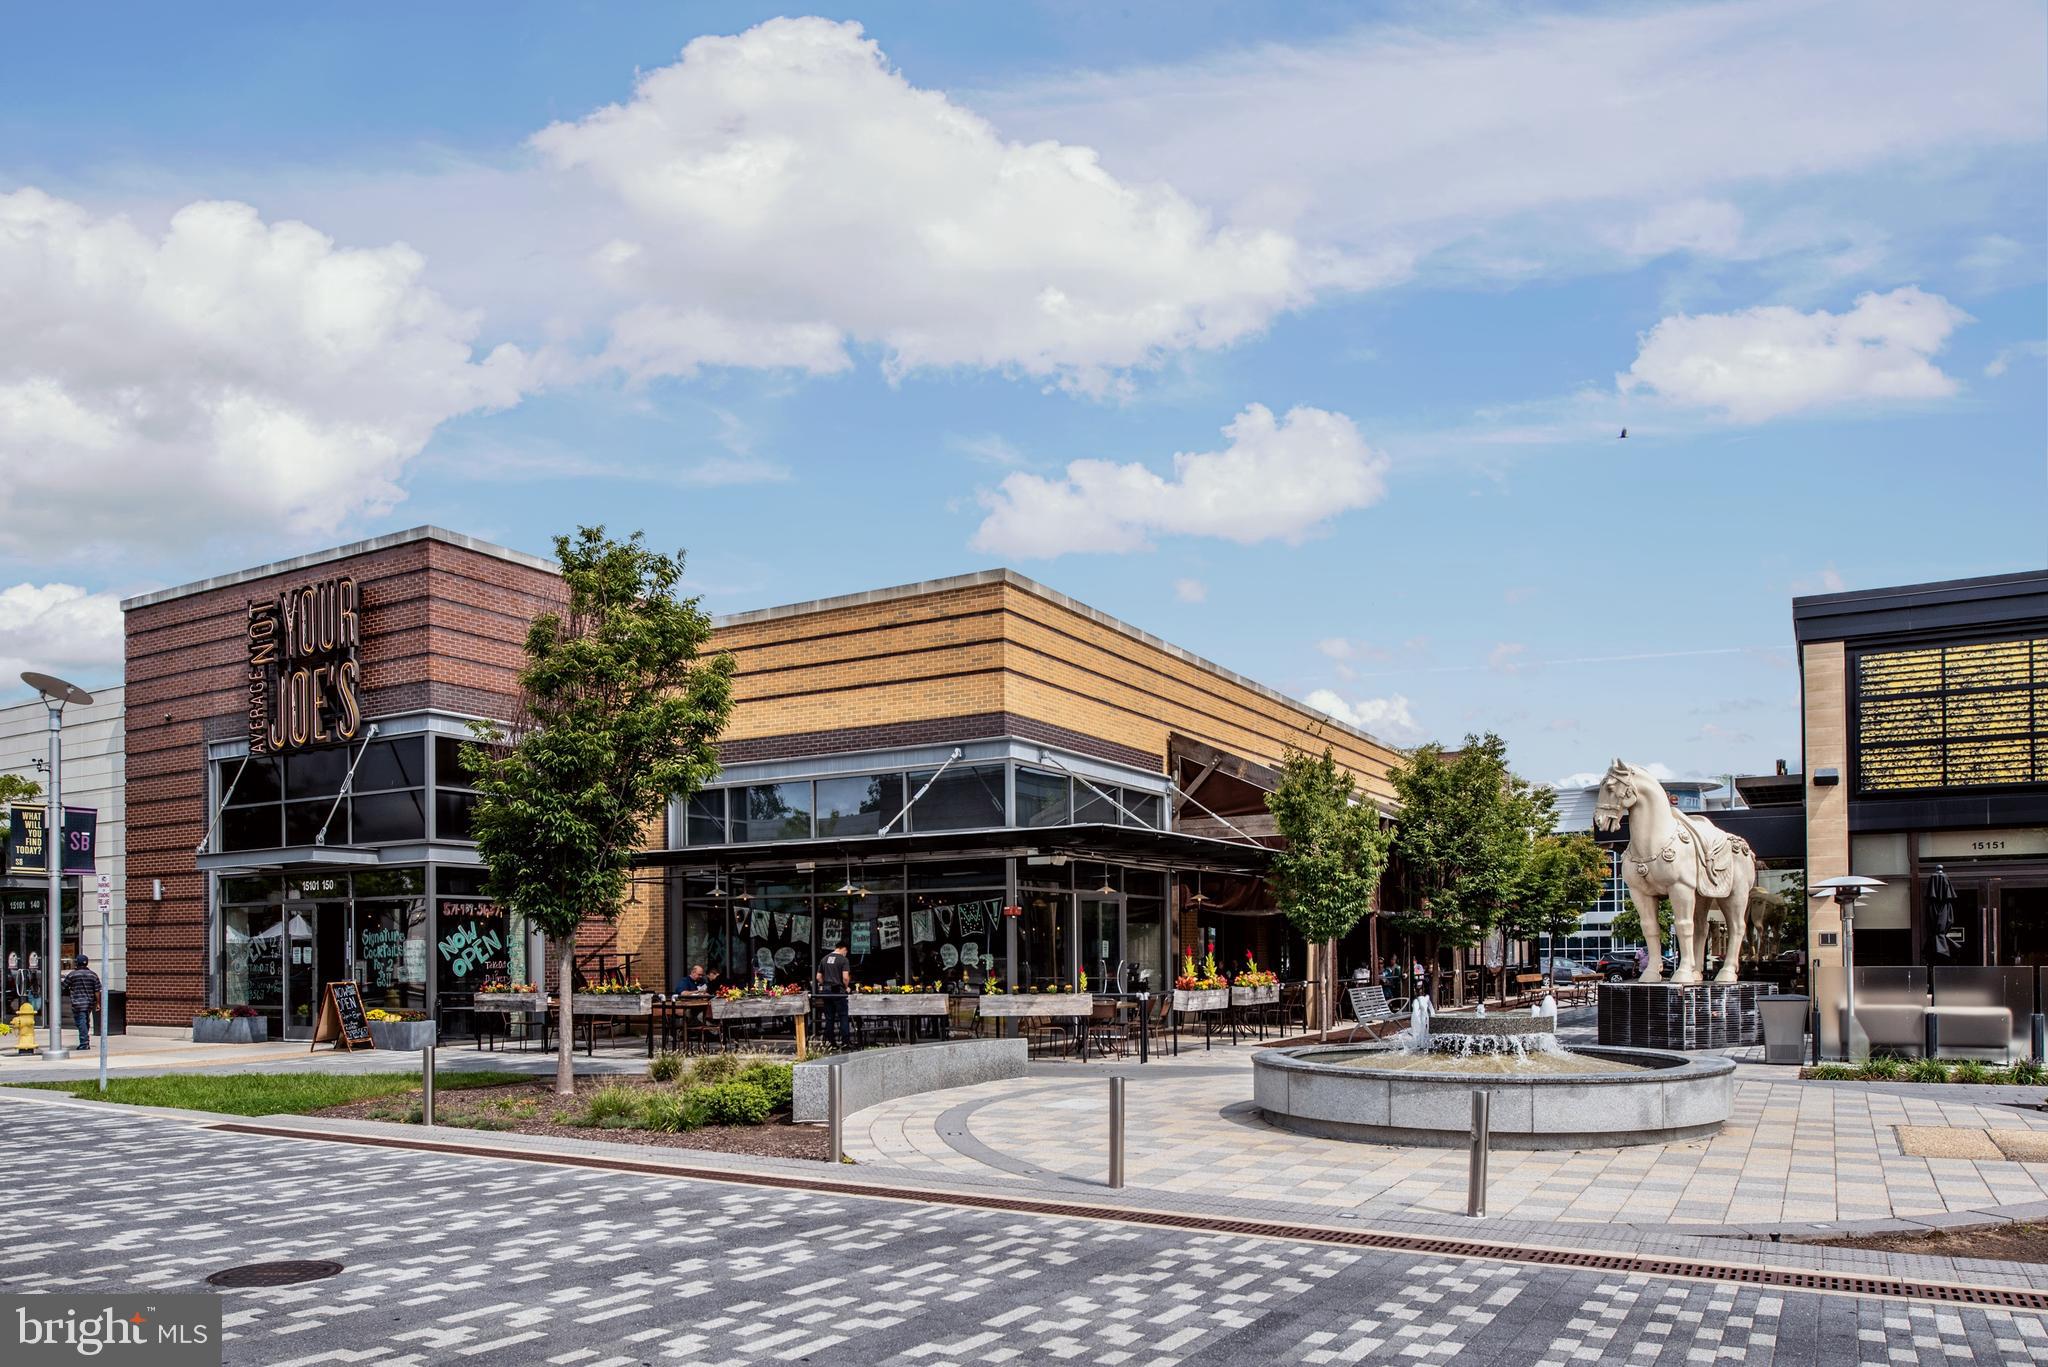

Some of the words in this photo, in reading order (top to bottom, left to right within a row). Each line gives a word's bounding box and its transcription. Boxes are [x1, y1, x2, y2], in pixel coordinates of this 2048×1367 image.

[280, 577, 359, 658] YOUR
[248, 600, 278, 666] NOT
[268, 658, 361, 750] JOE'S
[248, 669, 267, 755] AVERAGE
[22, 812, 42, 821] WHAT
[25, 821, 42, 829] WILL
[28, 830, 42, 838] YOU
[25, 838, 42, 846] FIND
[1972, 841, 2005, 850] 15151
[16, 846, 42, 855] TODAY?
[302, 880, 320, 891] 15101
[322, 880, 334, 890] 150
[10, 901, 26, 910] 15101
[30, 901, 40, 909] 140
[438, 921, 478, 961] NOW
[453, 929, 502, 977] OPEN
[386, 959, 393, 971] 2
[336, 996, 357, 1012] OPEN
